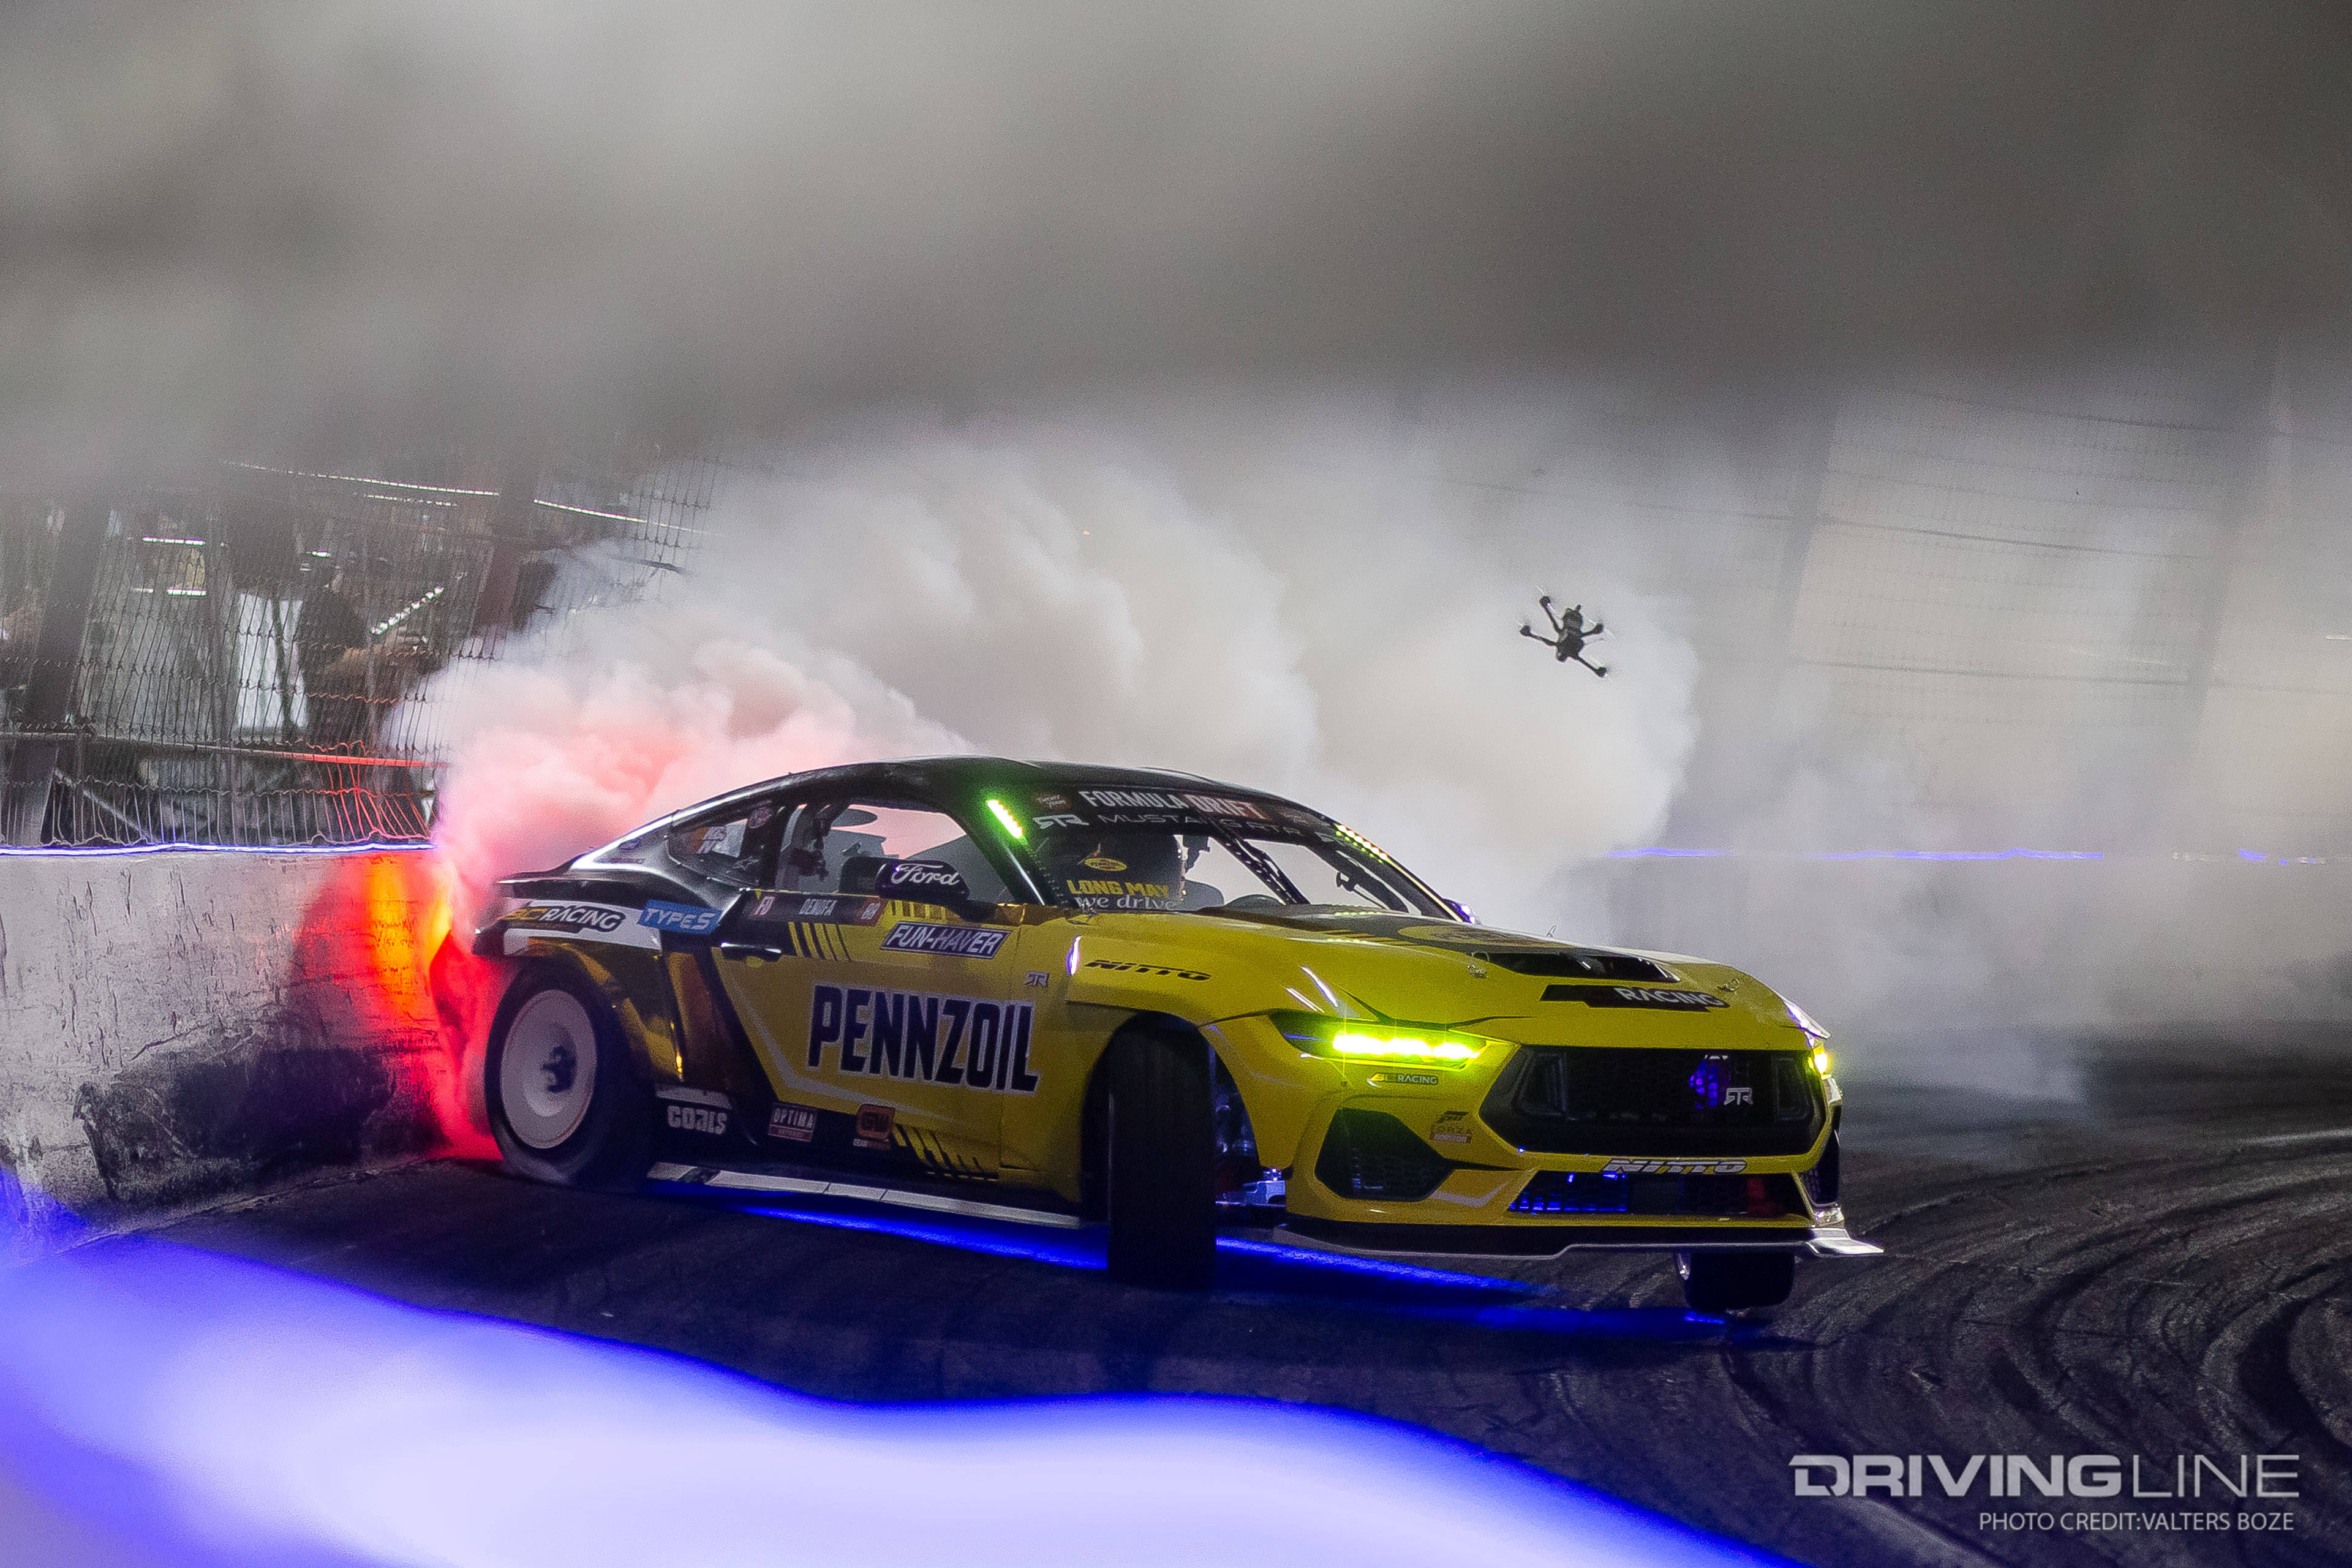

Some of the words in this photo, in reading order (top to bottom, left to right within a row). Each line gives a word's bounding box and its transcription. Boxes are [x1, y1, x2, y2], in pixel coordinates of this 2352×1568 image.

[1078, 790, 1189, 809] FORMULA
[1185, 794, 1268, 820] DRIFT
[1031, 813, 1090, 829] RTR
[890, 862, 960, 886] Ford
[1066, 879, 1123, 895] LONG
[1125, 881, 1169, 897] MAY
[1073, 896, 1109, 909] we
[539, 907, 623, 930] RACING
[886, 924, 1006, 955] FUN-HAVER
[1084, 959, 1212, 981] NITTO
[1613, 987, 1726, 1006] RACING
[806, 983, 1041, 1095] PENNZOIL
[1397, 1074, 1438, 1085] RACING
[1723, 1087, 1754, 1106] RTR
[773, 1107, 815, 1129] OPTIMA
[1601, 1159, 1747, 1174] NITTO
